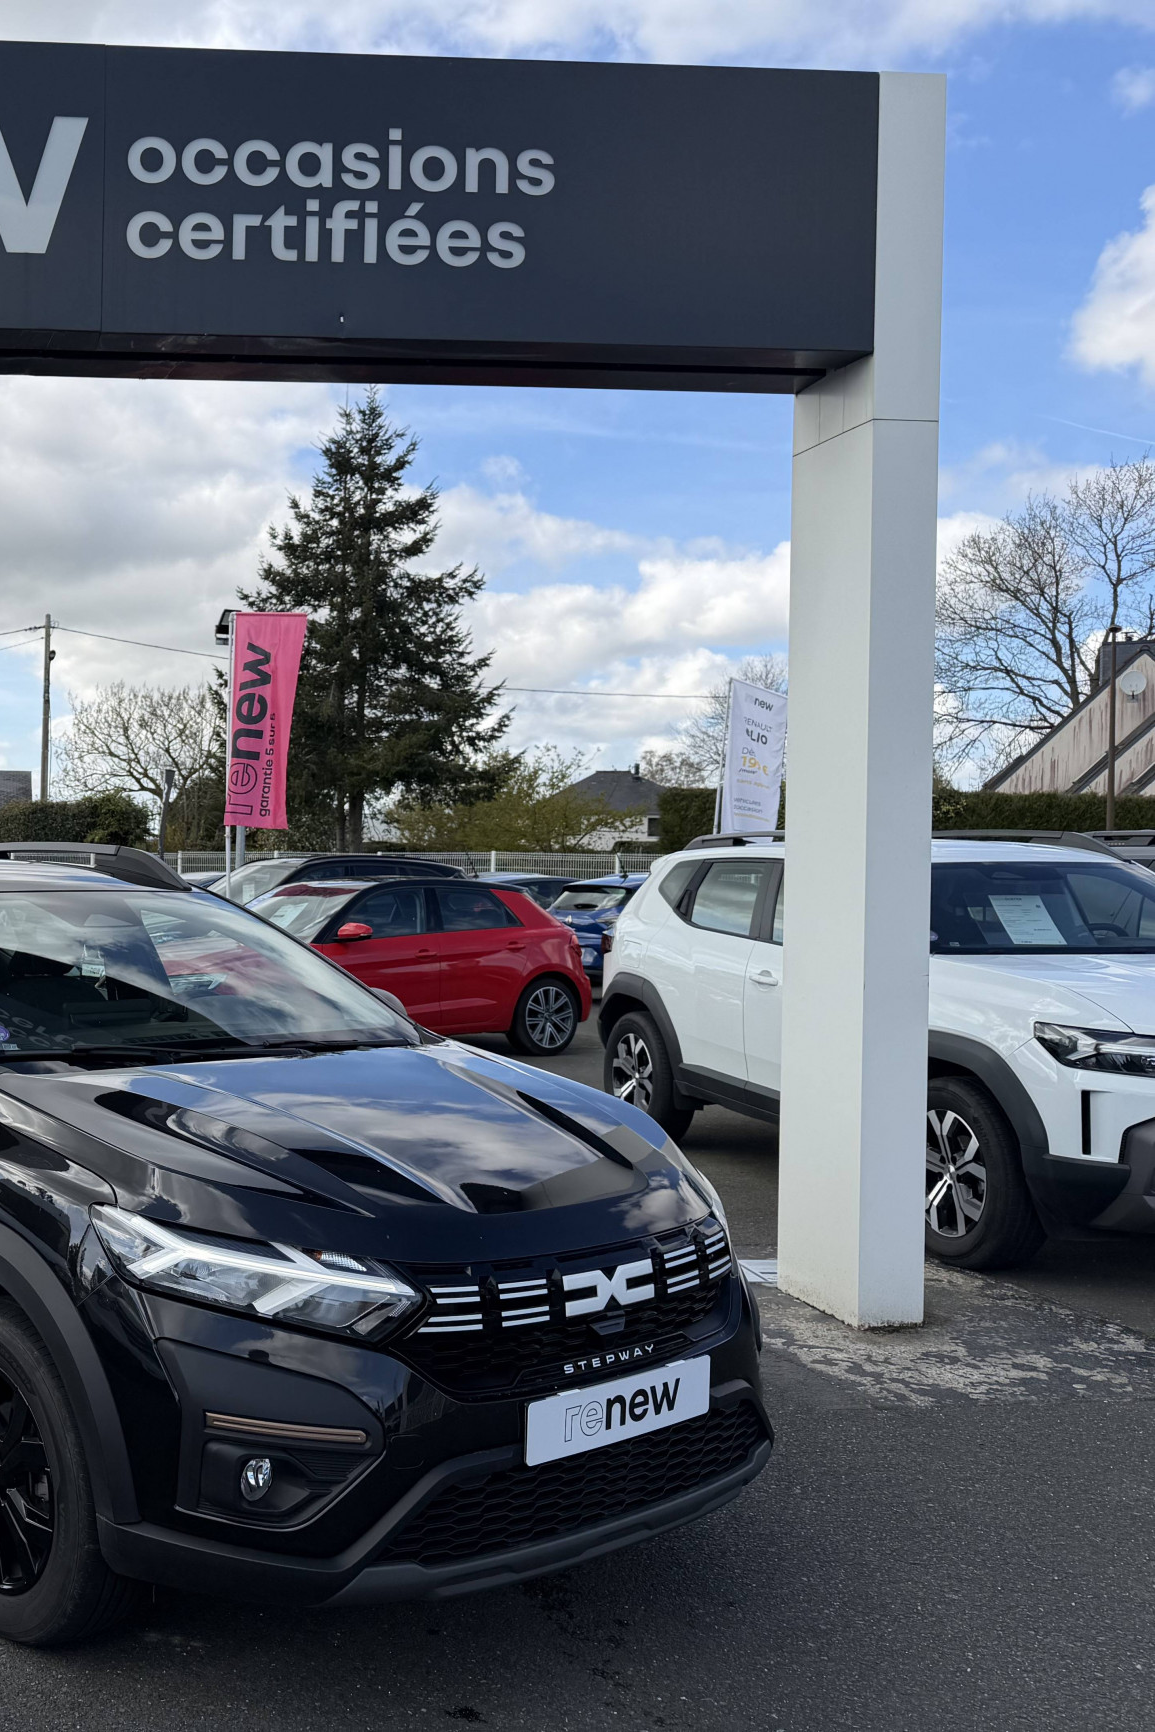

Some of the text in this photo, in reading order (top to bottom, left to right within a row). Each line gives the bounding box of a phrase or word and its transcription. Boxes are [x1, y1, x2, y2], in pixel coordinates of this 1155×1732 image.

[127, 127, 555, 196] occasions
[125, 198, 526, 269] certifiées
[225, 642, 272, 815] renew
[264, 747, 274, 756] 5
[267, 722, 276, 747] sur
[259, 759, 274, 817] garantie
[563, 1344, 654, 1374] STEPWAY
[564, 1377, 681, 1442] renew
